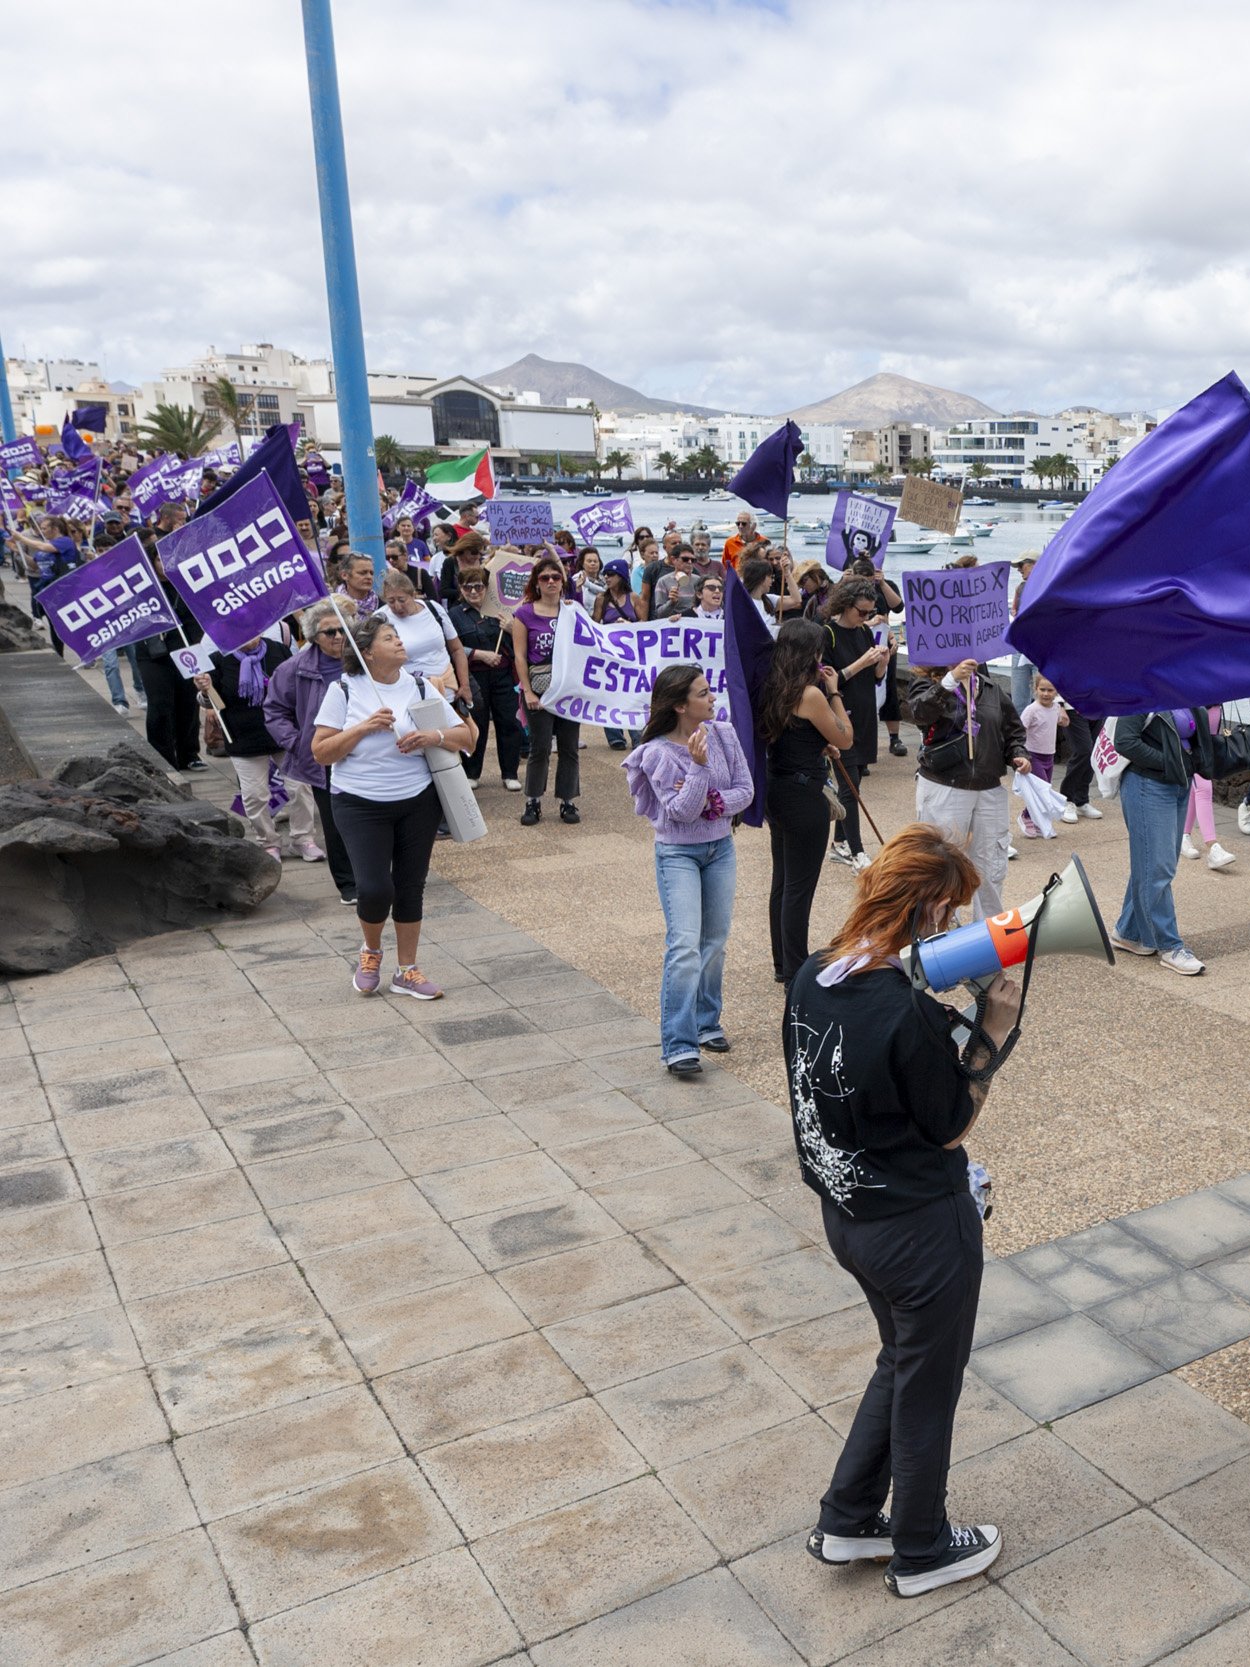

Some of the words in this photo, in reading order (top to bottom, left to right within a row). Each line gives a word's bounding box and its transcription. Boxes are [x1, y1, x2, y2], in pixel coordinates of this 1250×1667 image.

[490, 505, 504, 515] HA
[510, 504, 552, 515] LLEGADO
[510, 516, 529, 526] FIN
[494, 525, 554, 541] PATRIARCADO
[907, 577, 936, 602] NO
[940, 576, 987, 599] CALLES
[991, 567, 1005, 591] X
[911, 604, 943, 627] NO
[951, 600, 1004, 624] PROTEJAS
[573, 612, 723, 665] DESPERT
[917, 634, 929, 651] A
[935, 633, 971, 649] QUIEN
[555, 695, 651, 726] COLECTI
